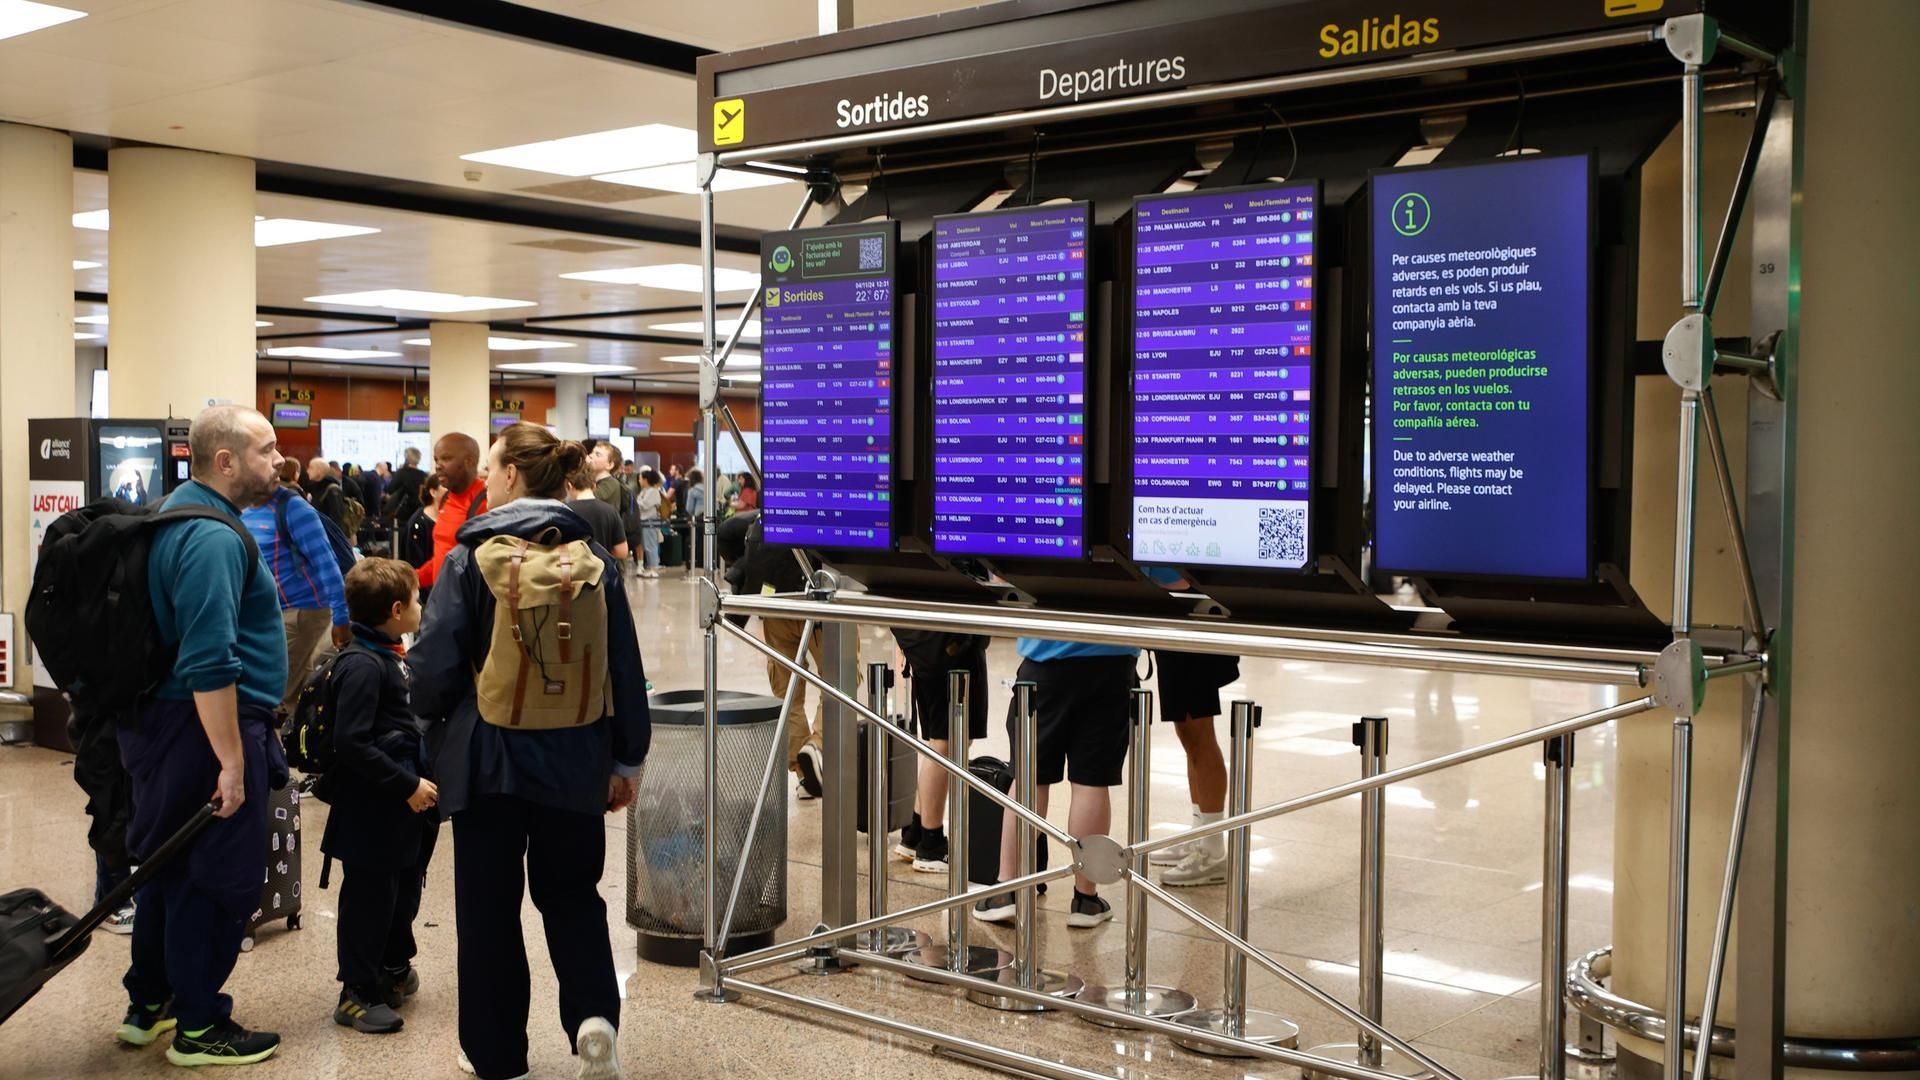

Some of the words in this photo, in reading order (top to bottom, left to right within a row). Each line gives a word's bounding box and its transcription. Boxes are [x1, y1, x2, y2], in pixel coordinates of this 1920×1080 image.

[1318, 15, 1439, 58] Salidas
[1039, 55, 1186, 100] Departures
[836, 91, 929, 129] Sortides
[1174, 221, 1206, 229] MALLORCA
[950, 240, 981, 248] AMSTERDAM
[1154, 244, 1184, 252] BUDAPEST
[1392, 254, 1409, 265] Per
[1412, 253, 1446, 263] causes
[1449, 247, 1536, 262] meteorològiques
[1392, 270, 1439, 282] adverses,
[1442, 269, 1454, 278] es
[1456, 267, 1488, 280] poden
[1492, 263, 1529, 278] produir
[1759, 264, 1775, 274] 39
[1392, 286, 1427, 298] retards
[1430, 286, 1442, 295] en
[1445, 284, 1459, 295] els
[1462, 284, 1485, 294] vols.
[1489, 281, 1498, 292] Si
[1501, 282, 1513, 291] us
[1517, 280, 1542, 294] plau,
[784, 290, 824, 302] Sortides
[1392, 303, 1435, 313] contacta
[1438, 301, 1459, 312] amb
[1462, 300, 1471, 311] la
[1474, 300, 1497, 310] teva
[1392, 318, 1445, 331] companyia
[1448, 317, 1476, 327] aèria.
[949, 358, 982, 366] MANCHESTER
[1393, 353, 1410, 363] Por
[1413, 352, 1449, 363] causas
[1452, 349, 1536, 362] meteorológicas
[1393, 370, 1442, 380] adversas,
[1445, 367, 1485, 380] pueden
[1489, 366, 1548, 379] producirse
[1393, 386, 1435, 395] retrasos
[1439, 385, 1451, 394] en
[1455, 384, 1470, 394] los
[1473, 383, 1512, 394] vuelos.
[298, 391, 310, 400] 65
[1393, 401, 1410, 411] Por
[1414, 401, 1443, 412] favor,
[1446, 400, 1492, 410] contacta
[1495, 400, 1514, 410] con
[1518, 400, 1530, 410] tu
[1393, 417, 1443, 430] compañía
[1446, 418, 1478, 427] aérea.
[52, 448, 70, 459] vending
[1393, 450, 1413, 461] Due
[1416, 451, 1426, 461] to
[1429, 450, 1469, 461] adverse
[1471, 451, 1515, 462] weather
[1393, 466, 1447, 478] conditions,
[1450, 467, 1482, 480] flights
[1485, 469, 1507, 480] may
[1510, 468, 1523, 478] be
[1393, 482, 1434, 495] delayed.
[1437, 483, 1471, 494] Please
[1473, 485, 1512, 495] contact
[34, 495, 57, 512] LAST
[1393, 500, 1416, 511] your
[1418, 499, 1451, 510] airline.
[1138, 505, 1154, 513] Com
[1157, 505, 1170, 513] has
[1172, 506, 1203, 515] d'actuar
[1164, 517, 1216, 527] d'emergència
